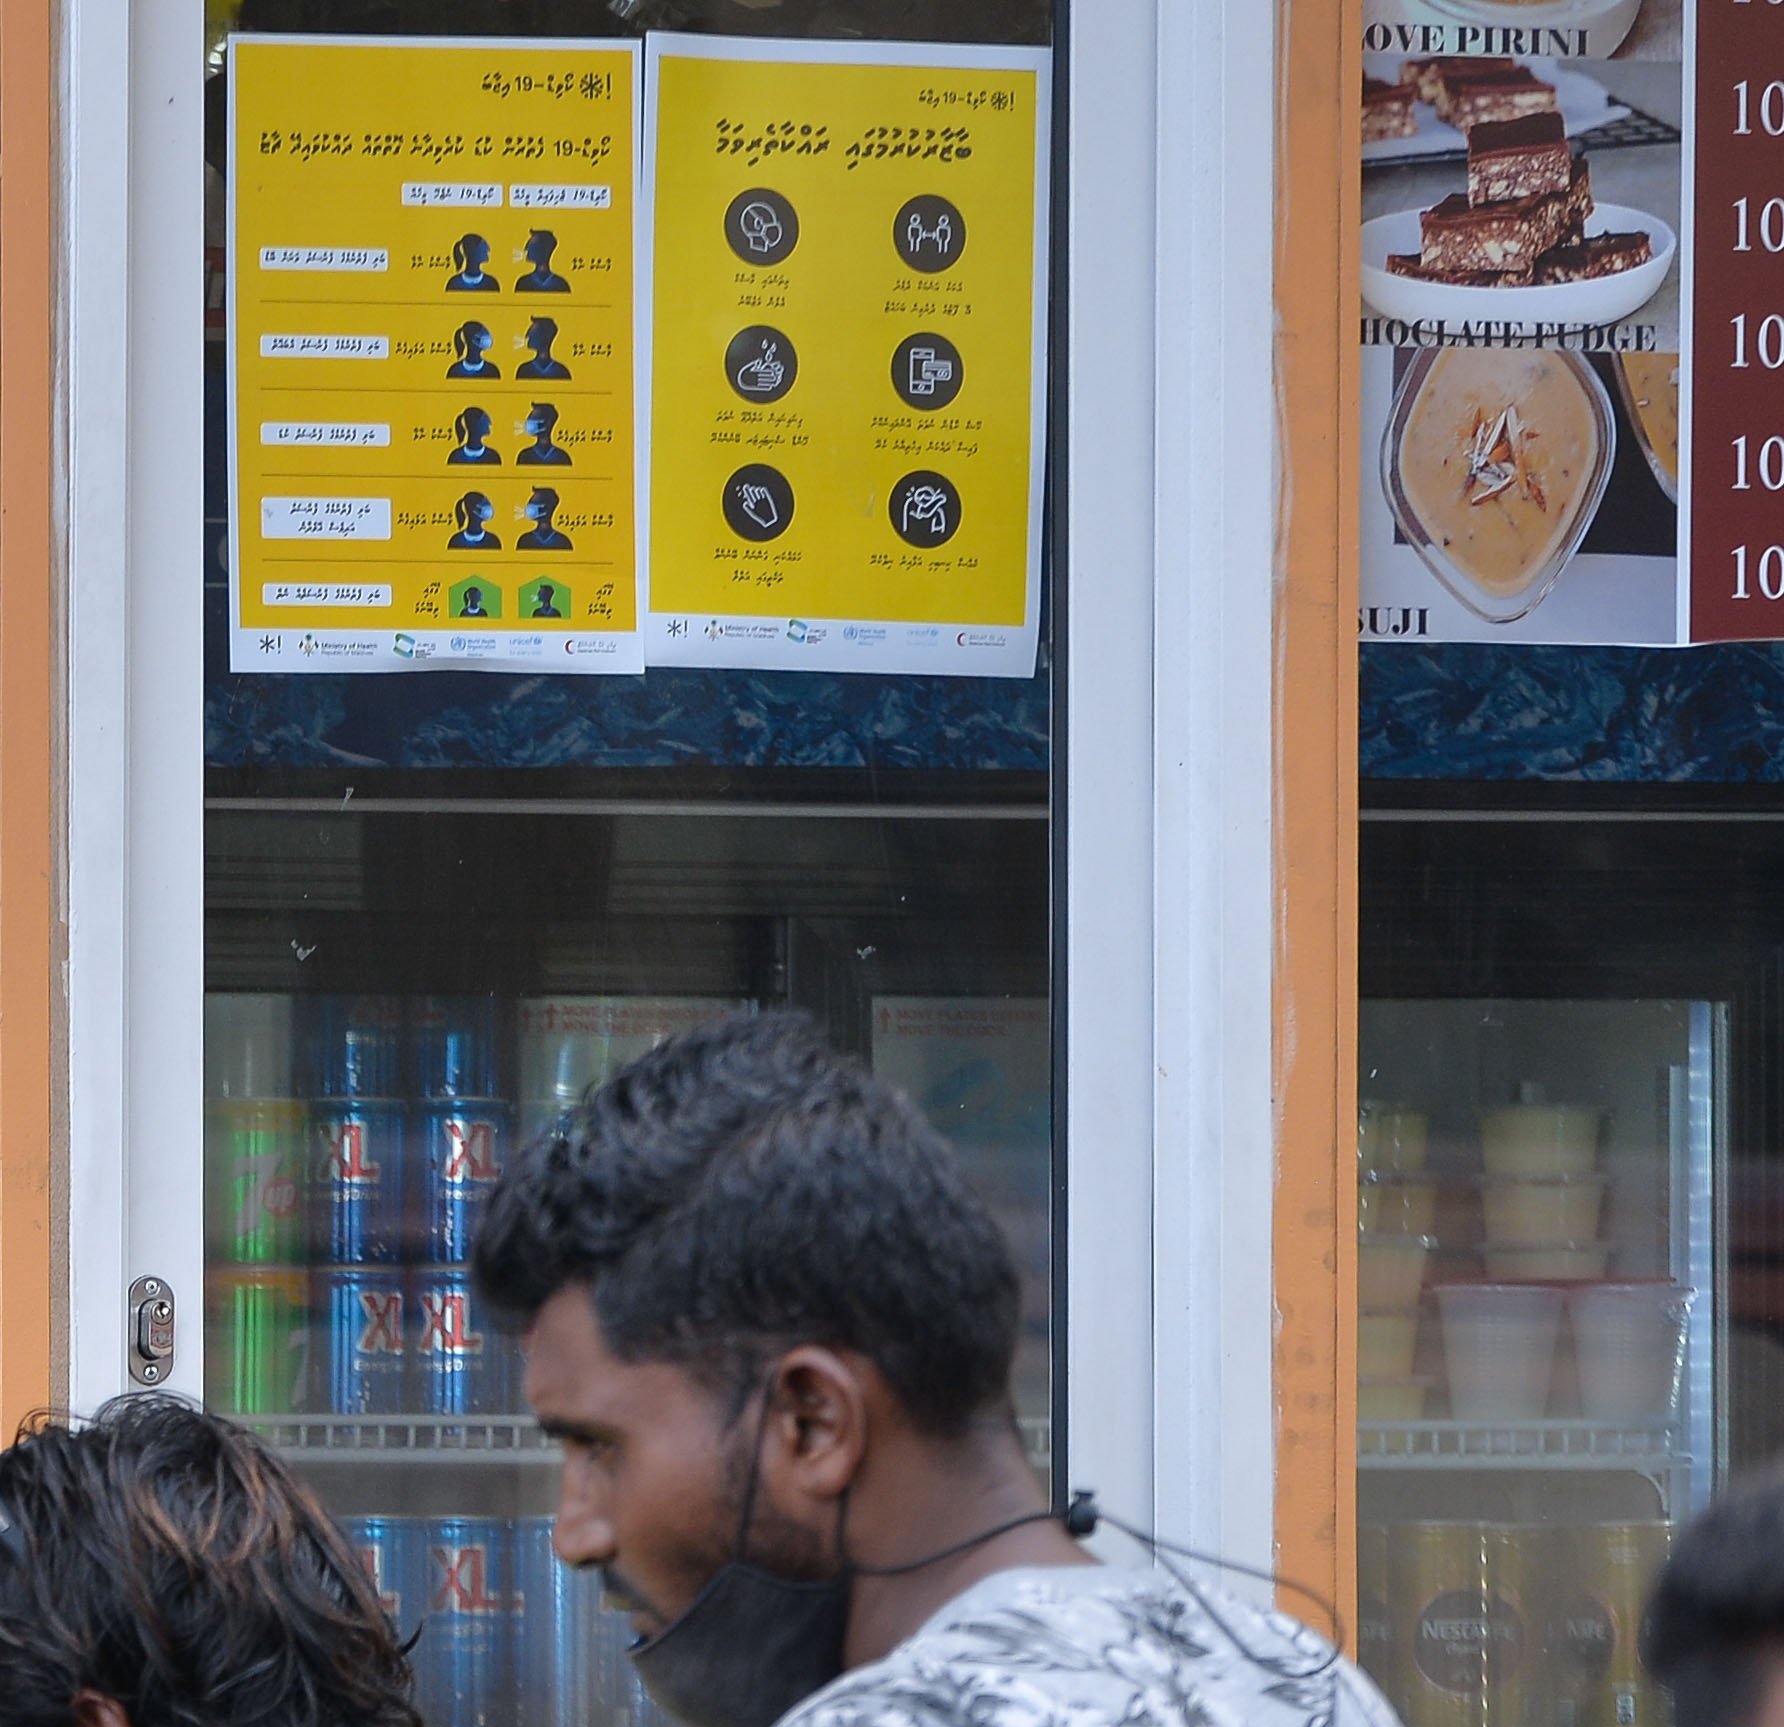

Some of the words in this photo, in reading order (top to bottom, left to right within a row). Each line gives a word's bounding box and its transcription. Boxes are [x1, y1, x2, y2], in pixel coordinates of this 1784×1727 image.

[1361, 22, 1445, 53] OVE
[1455, 25, 1590, 58] PIRINI
[1534, 322, 1657, 353] FUDGE
[317, 1119, 381, 1184] XL
[444, 1118, 504, 1184] XL
[419, 1290, 483, 1356] XL
